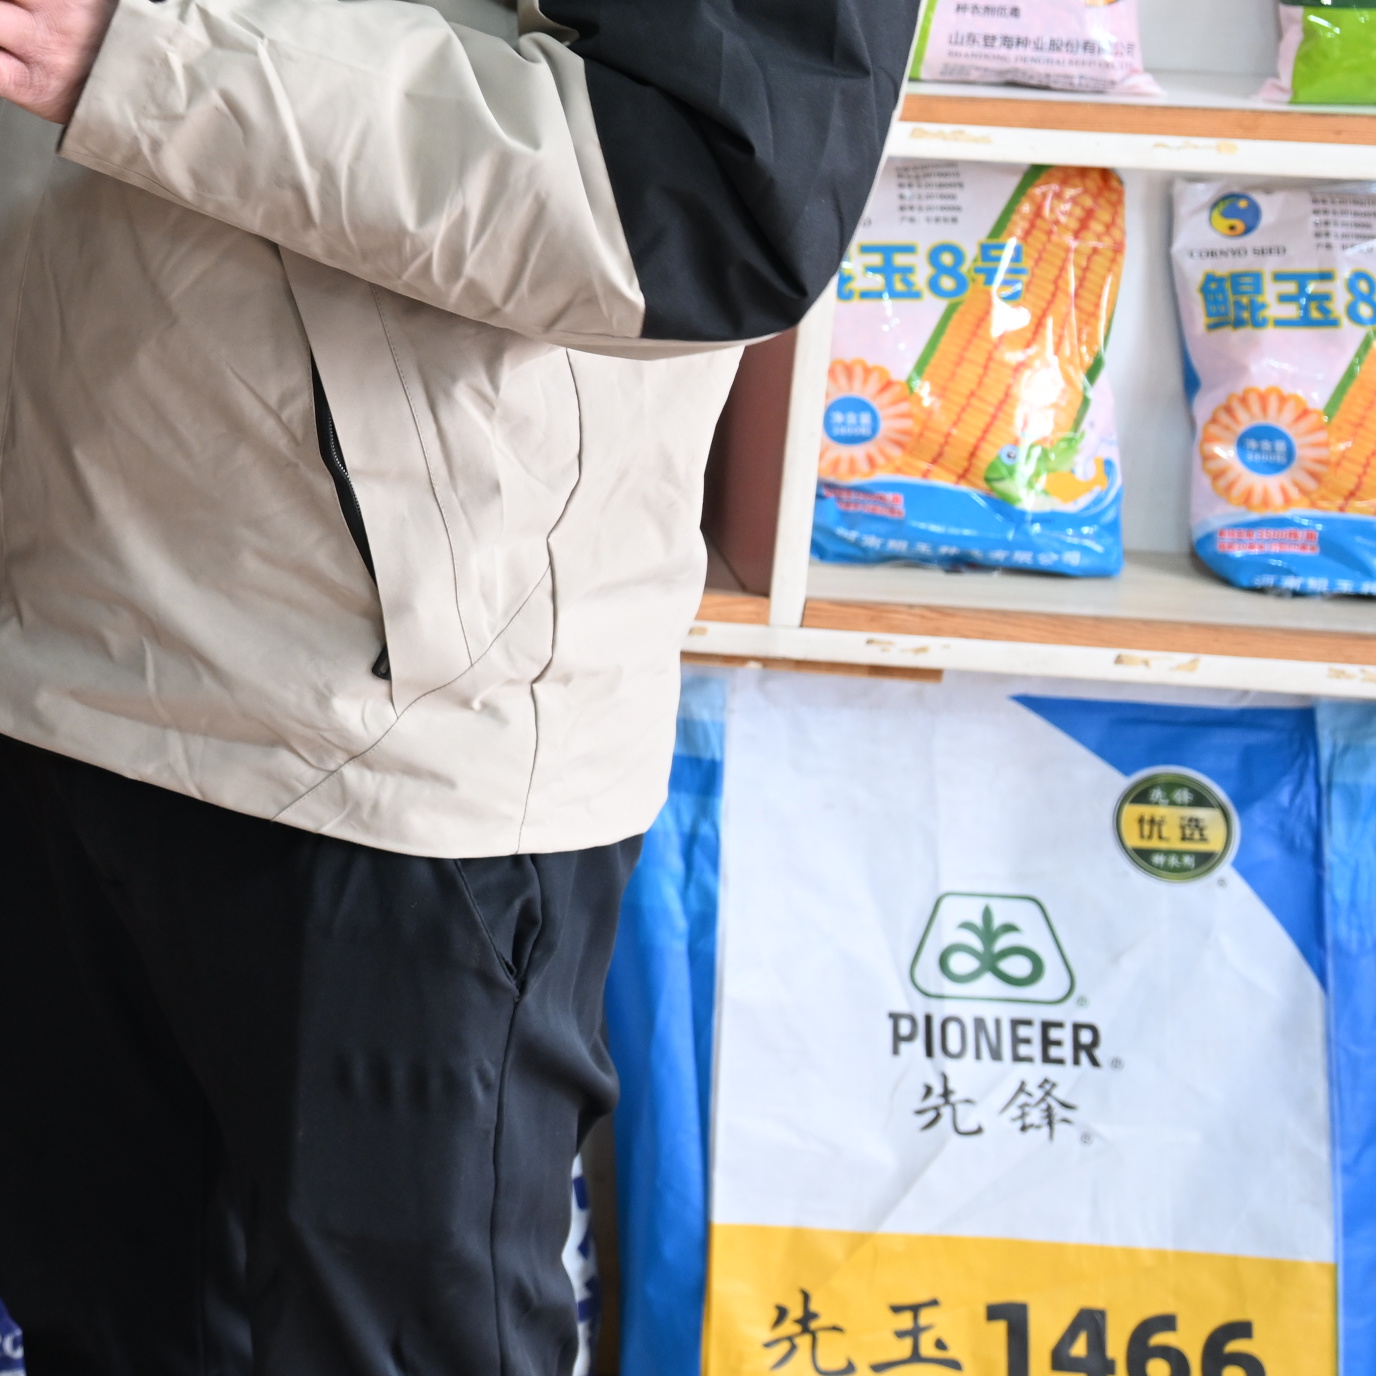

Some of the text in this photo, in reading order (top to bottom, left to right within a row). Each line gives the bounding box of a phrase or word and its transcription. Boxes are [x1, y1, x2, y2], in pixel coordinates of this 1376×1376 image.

[1136, 813, 1210, 842] 优选
[886, 1011, 1104, 1069] PIONEER
[911, 1072, 1080, 1142] 先锋
[761, 1287, 1269, 1376] 先玉1466
